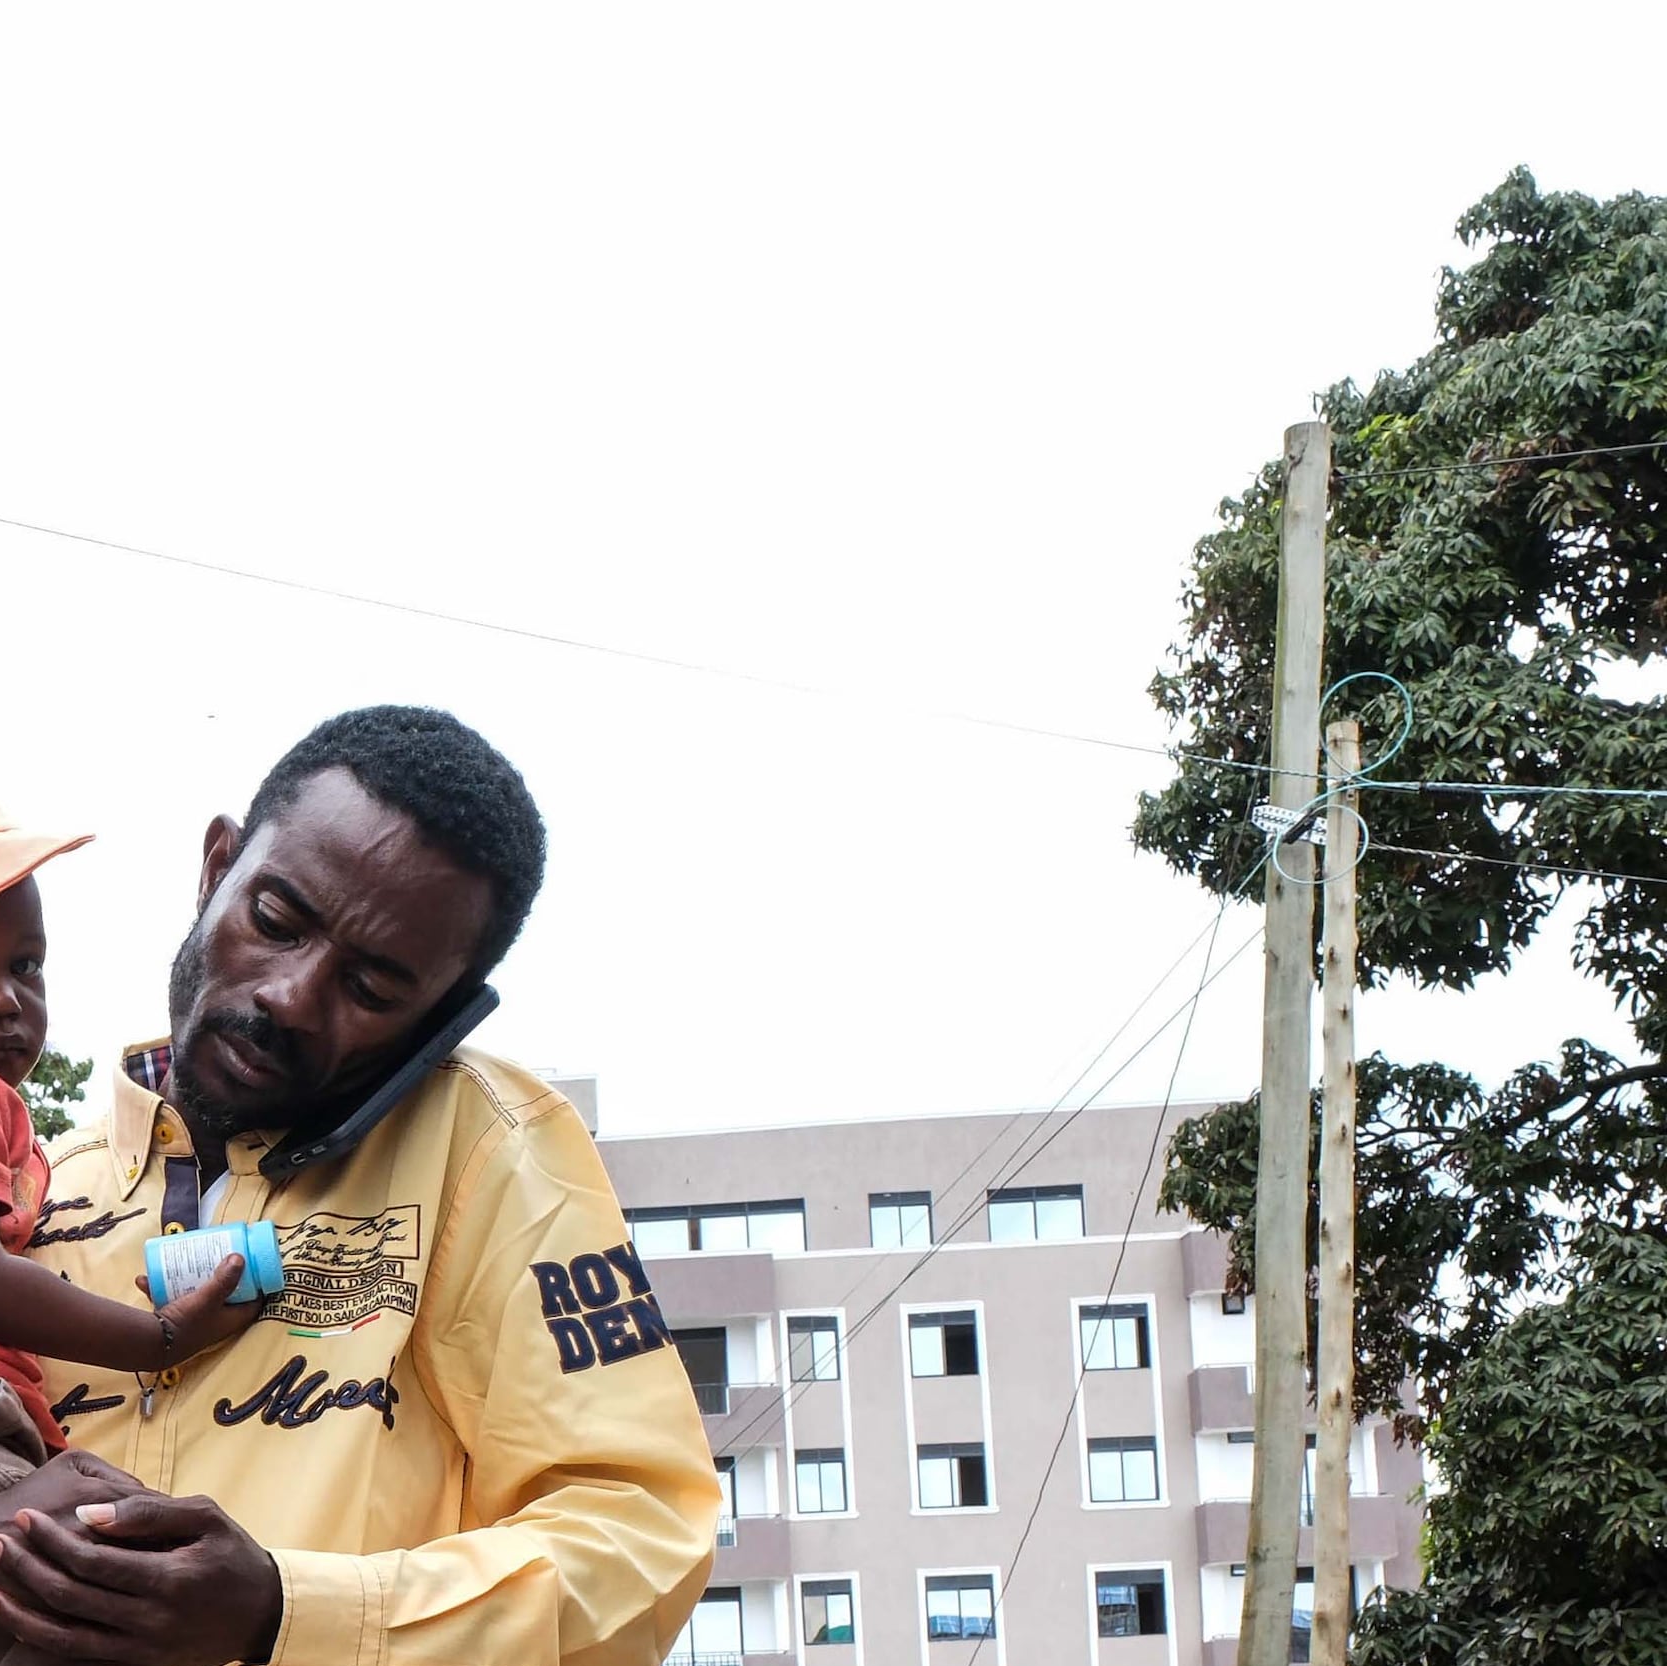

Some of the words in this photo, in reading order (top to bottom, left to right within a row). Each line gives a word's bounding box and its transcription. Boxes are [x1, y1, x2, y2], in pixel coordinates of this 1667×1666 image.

[283, 1271, 345, 1291] RIGINAL
[323, 1298, 351, 1311] BEST
[376, 1282, 413, 1299] ACTION
[306, 1311, 332, 1324] SOLO
[333, 1305, 369, 1323] SAILOR
